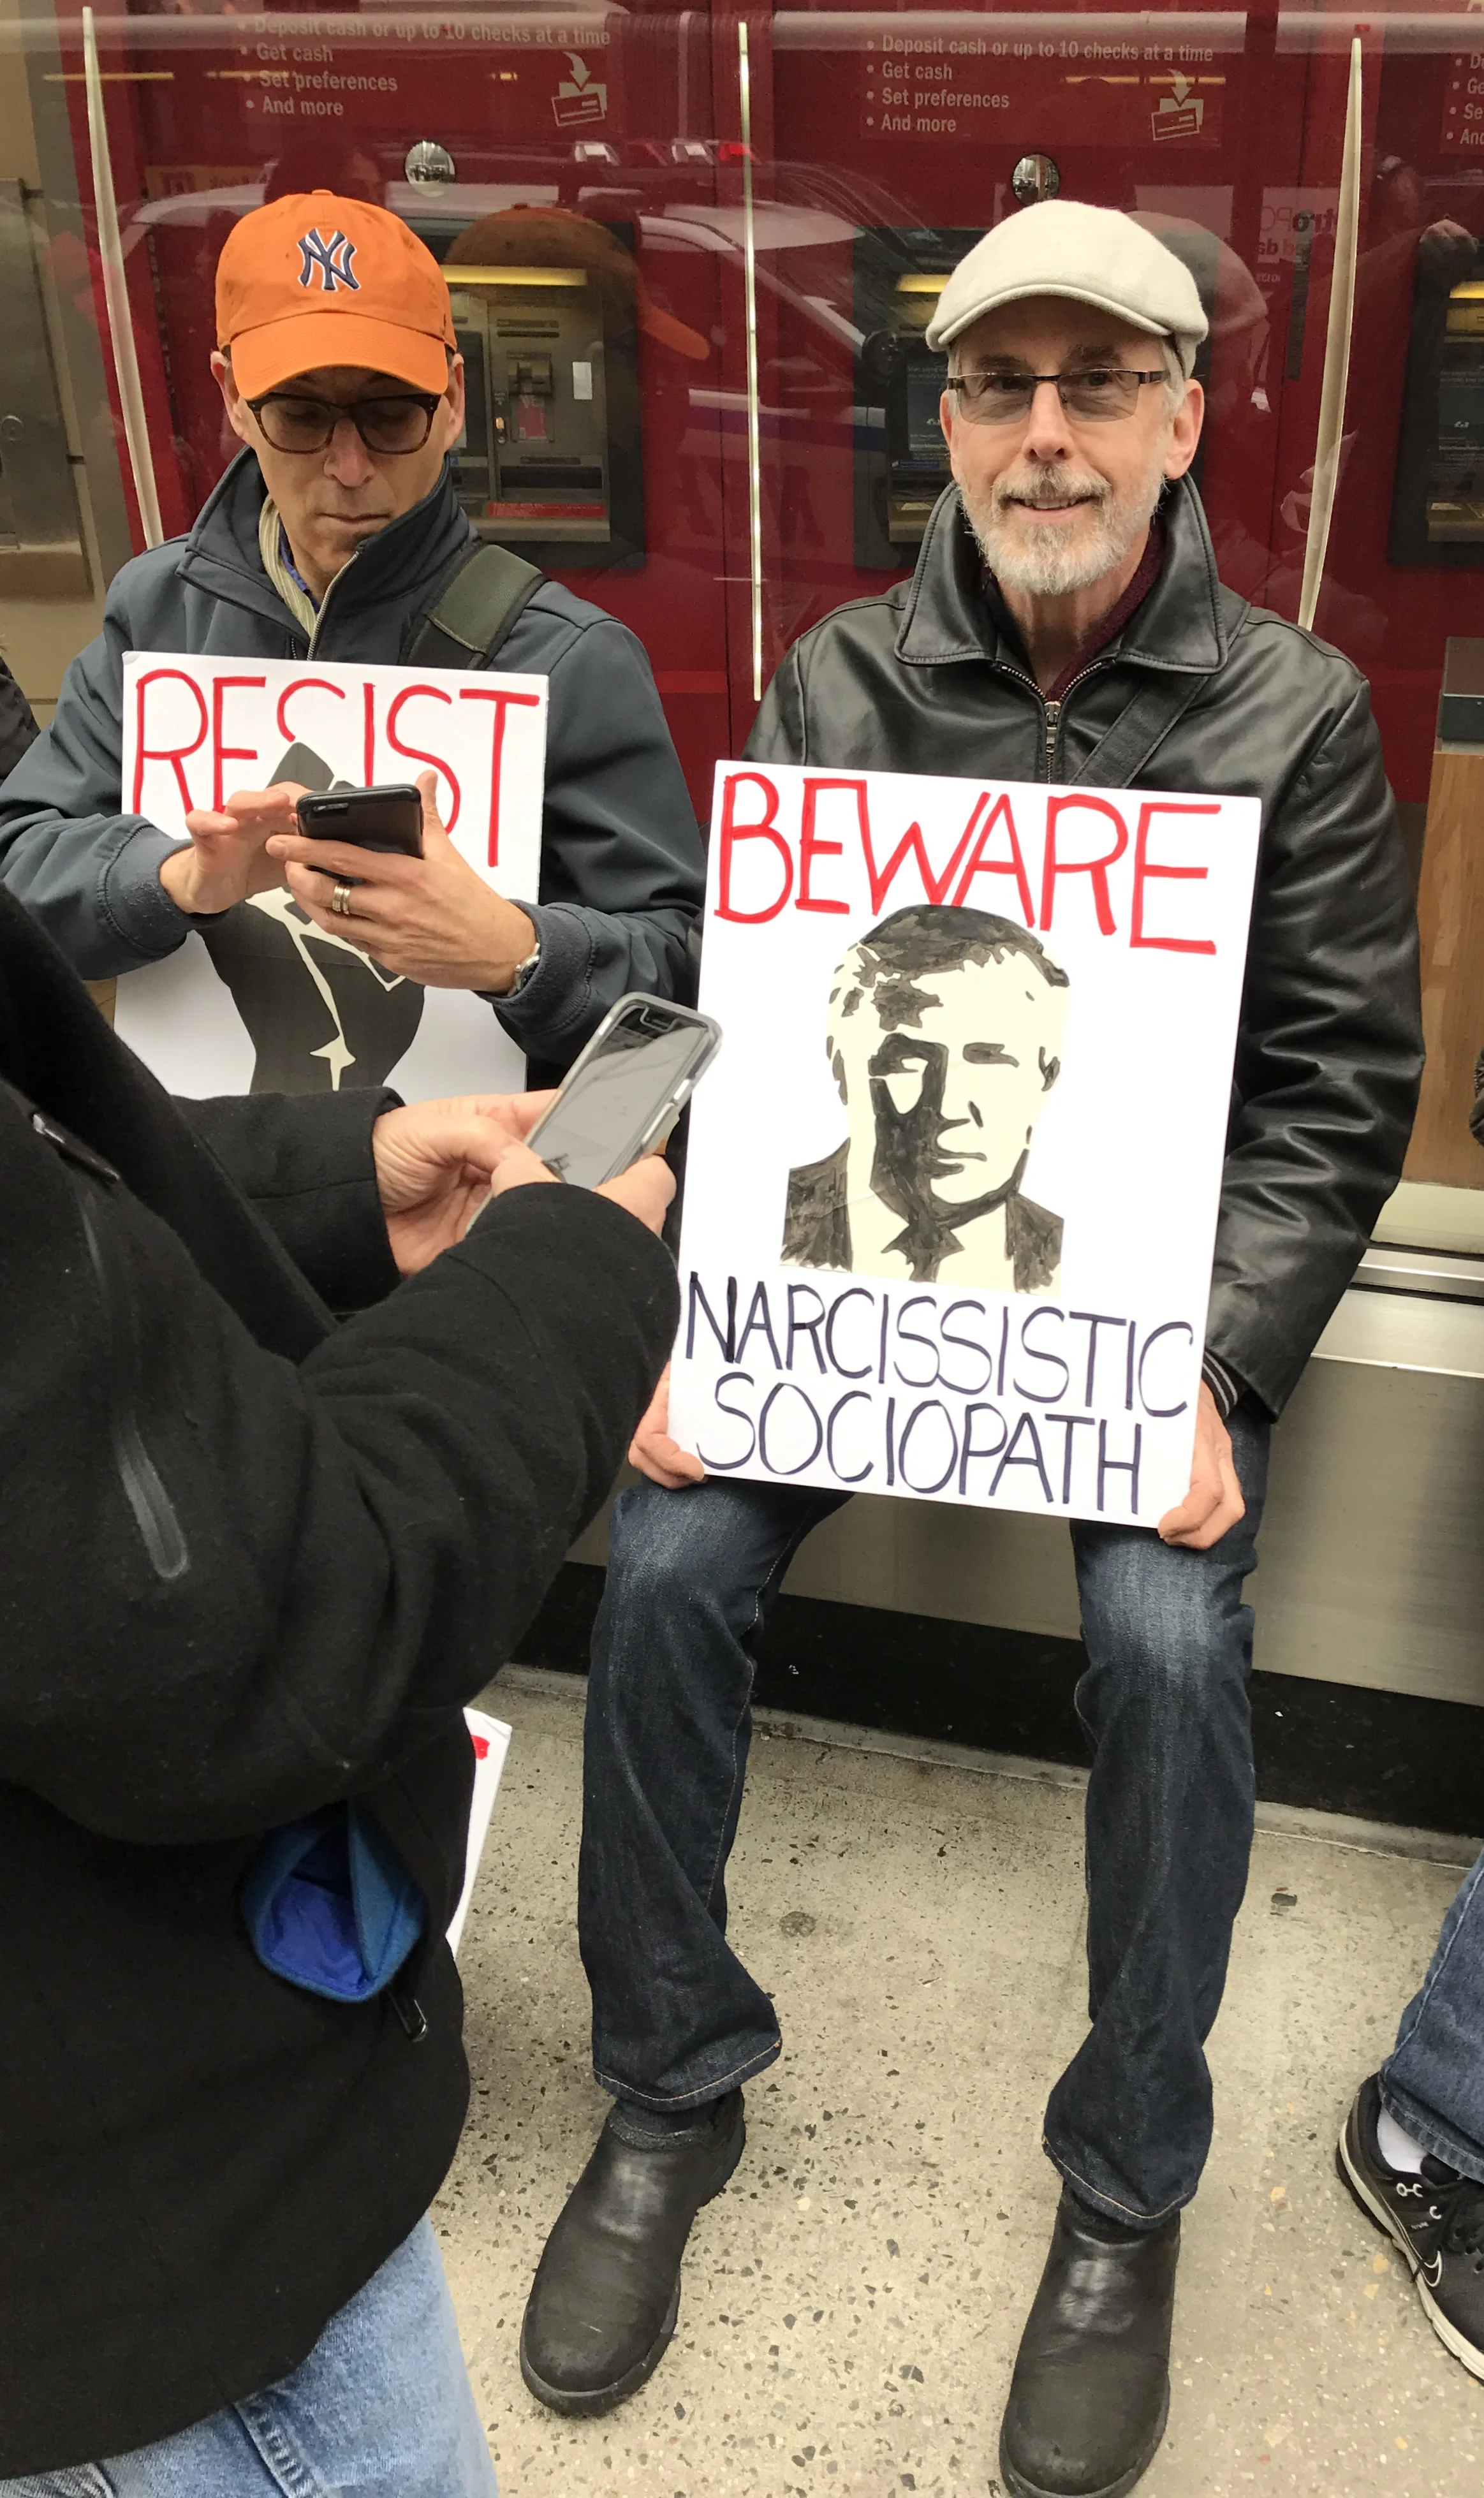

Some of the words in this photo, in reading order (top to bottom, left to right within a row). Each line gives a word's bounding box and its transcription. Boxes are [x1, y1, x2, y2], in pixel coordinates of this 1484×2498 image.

[256, 18, 320, 38] Deposit
[325, 20, 366, 36] cash
[372, 25, 391, 37] or
[396, 26, 416, 41] up
[421, 24, 439, 38] to
[444, 24, 464, 40] 10
[471, 24, 531, 43] checks
[536, 29, 553, 43] at
[558, 31, 568, 44] a
[573, 27, 610, 46] time
[256, 43, 289, 61] Get
[293, 45, 334, 62] cash
[882, 35, 944, 55] Deposit
[949, 39, 986, 56] cash
[992, 43, 1007, 56] or
[1013, 42, 1032, 60] up
[1038, 41, 1054, 57] to
[1059, 41, 1078, 57] 10
[1084, 42, 1138, 60] checks
[1143, 45, 1160, 60] at
[1164, 47, 1174, 61] a
[1179, 45, 1213, 62] time
[882, 62, 909, 80] Get
[915, 64, 953, 80] cash
[259, 71, 290, 89] Set
[293, 71, 398, 92] preferences
[1467, 78, 1484, 94] Ge
[262, 96, 294, 114] And
[300, 99, 344, 116] more
[881, 89, 908, 105] Set
[915, 89, 1010, 108] preferences
[1464, 102, 1484, 120] Se
[881, 115, 911, 131] And
[916, 119, 956, 133] more
[296, 227, 362, 292] NY
[714, 772, 1221, 954] BEWARE
[686, 1271, 1194, 1418] NARCISSISTIC
[696, 1371, 1142, 1515] SOCIOPATH
